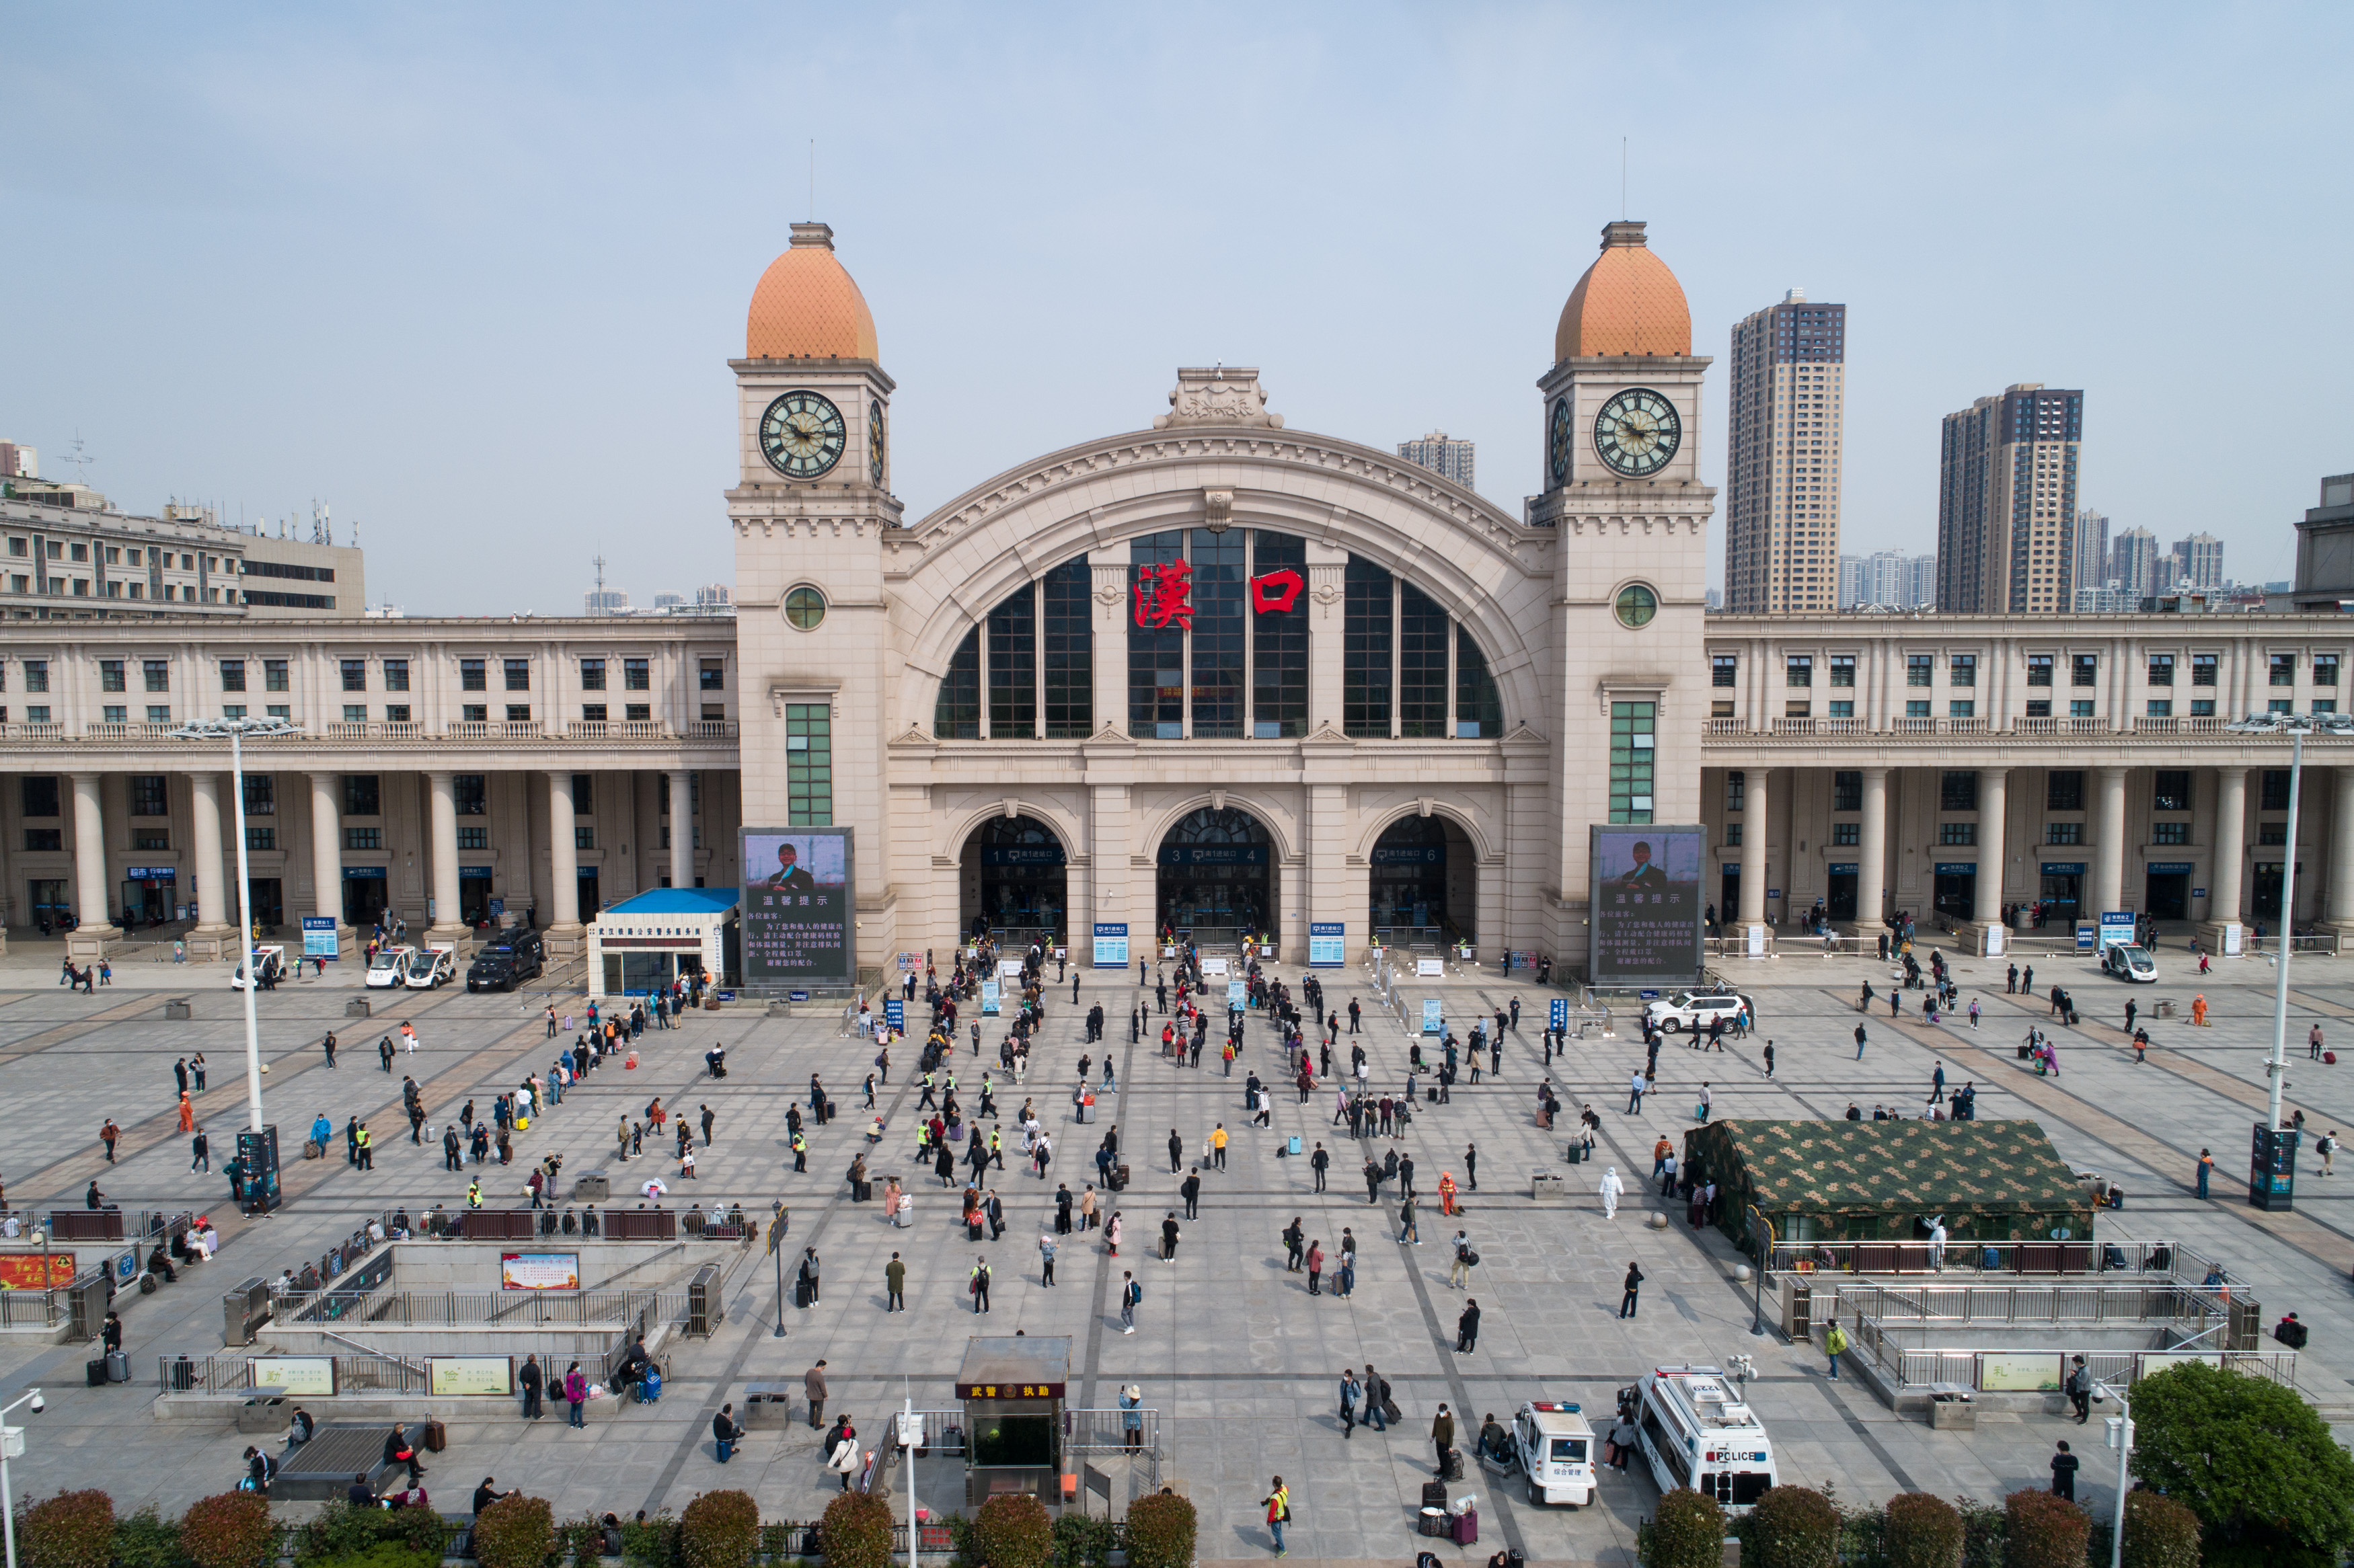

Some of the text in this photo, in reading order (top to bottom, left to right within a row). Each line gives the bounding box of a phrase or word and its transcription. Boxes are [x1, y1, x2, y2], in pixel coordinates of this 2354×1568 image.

[993, 851, 999, 861] 1
[1173, 851, 1180, 861] 3
[1248, 851, 1255, 861] 4
[1428, 850, 1435, 861] 6
[130, 868, 147, 876] 超市
[763, 896, 828, 906] 温馨提示
[1616, 894, 1680, 904] 温馨提示
[599, 927, 700, 935] 武汉铁路公安警务服务岗
[122, 1258, 130, 1267] 22
[333, 1257, 339, 1267] 22
[266, 1370, 281, 1382] 勤
[444, 1370, 459, 1382] 俭
[1994, 1366, 2008, 1377] 礼
[972, 1386, 1049, 1397] 武警 执勤
[1718, 1452, 1755, 1460] POLICE
